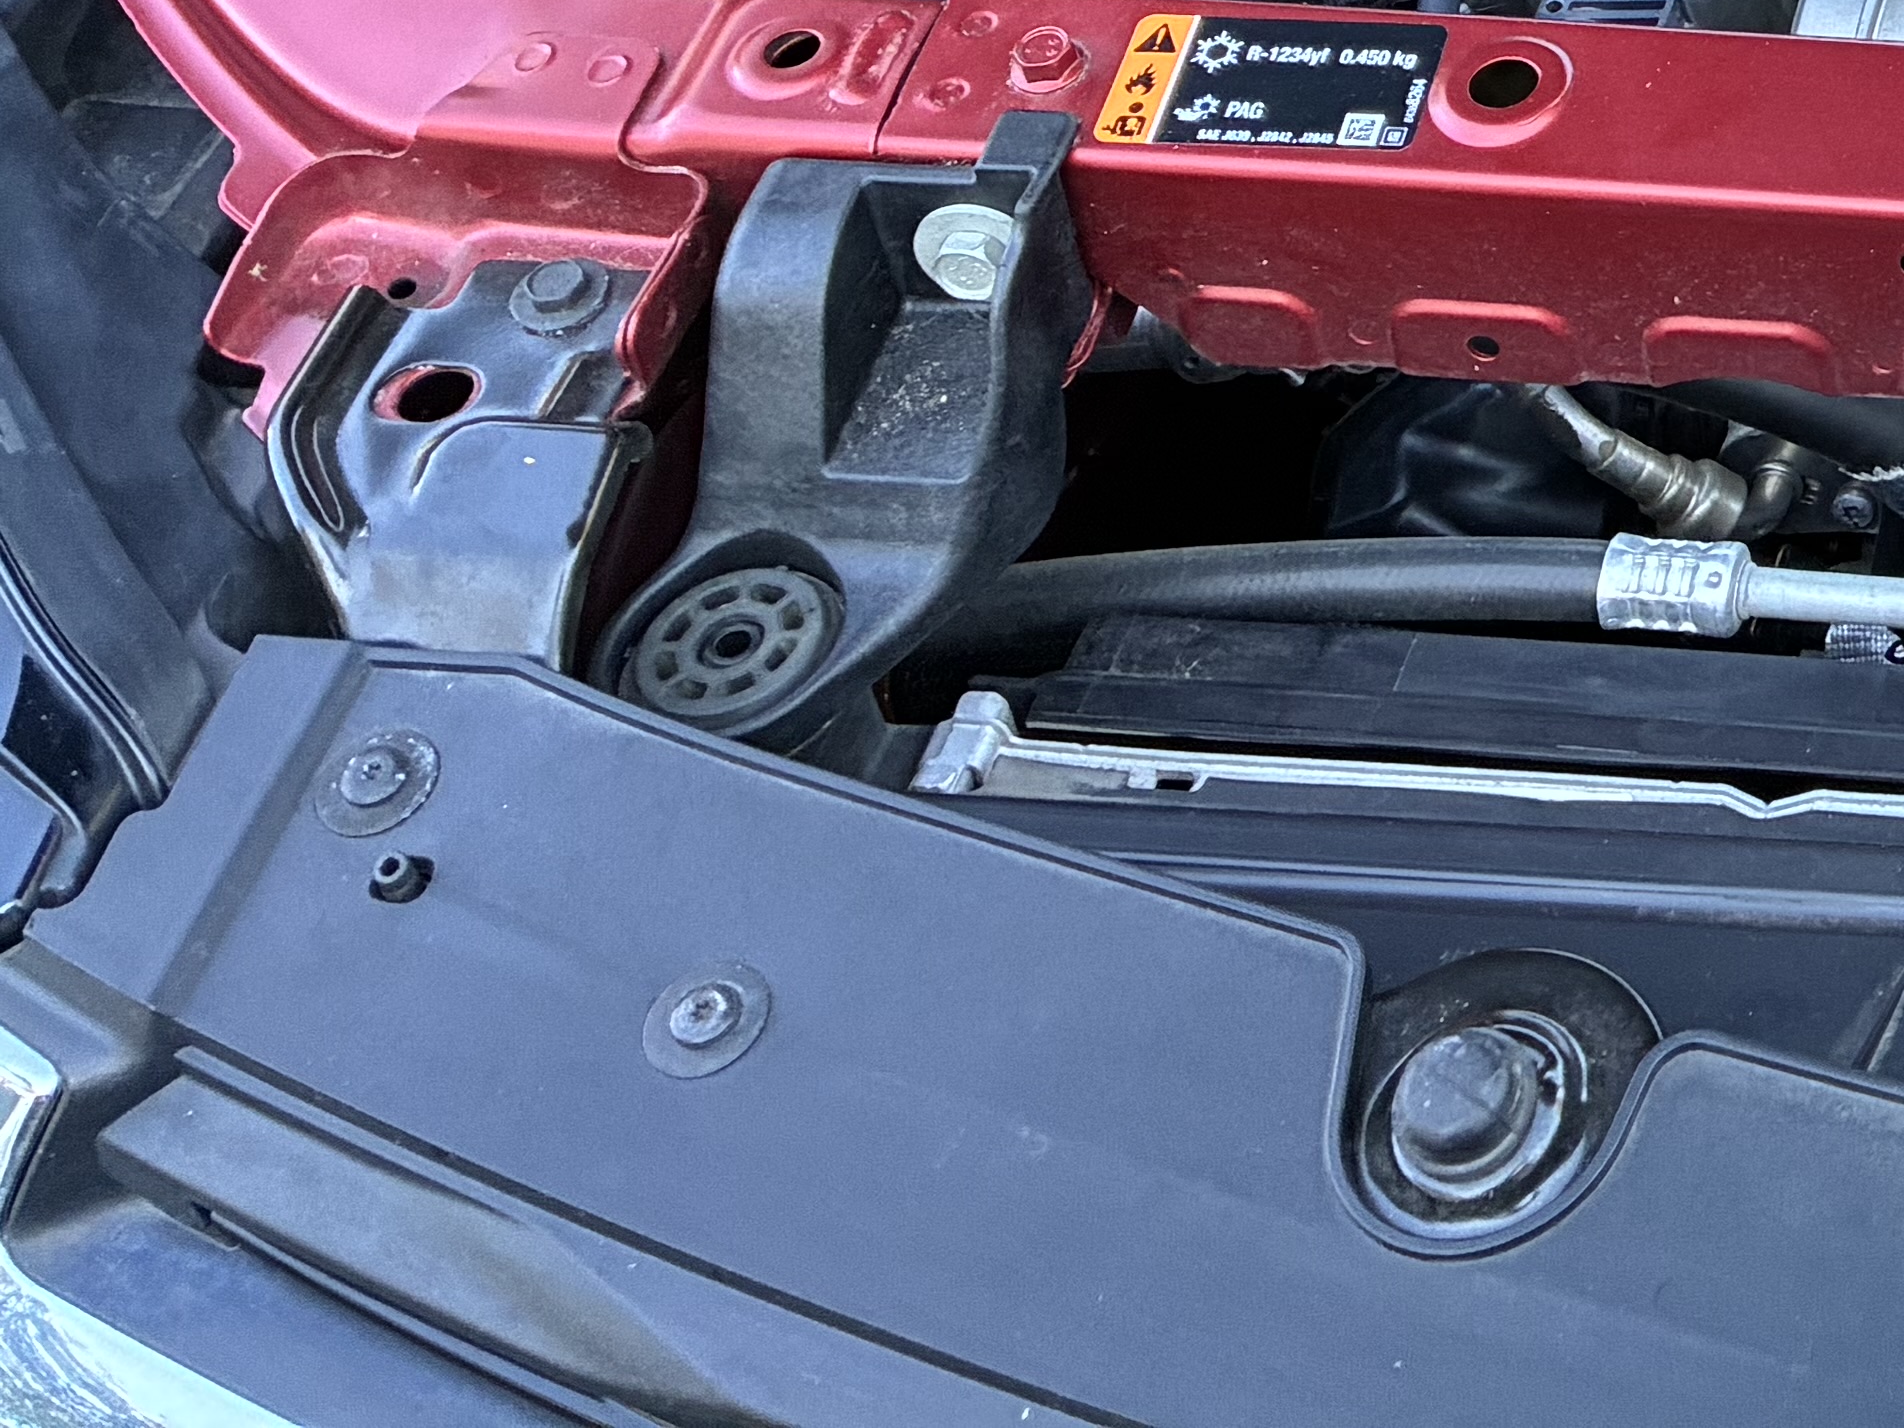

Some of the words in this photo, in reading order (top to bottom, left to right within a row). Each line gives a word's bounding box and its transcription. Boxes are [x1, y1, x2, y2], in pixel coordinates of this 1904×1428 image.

[1245, 44, 1332, 67] R-1234yf
[1338, 48, 1392, 67] 0.450
[1392, 50, 1419, 71] kg
[1223, 100, 1266, 120] PAG
